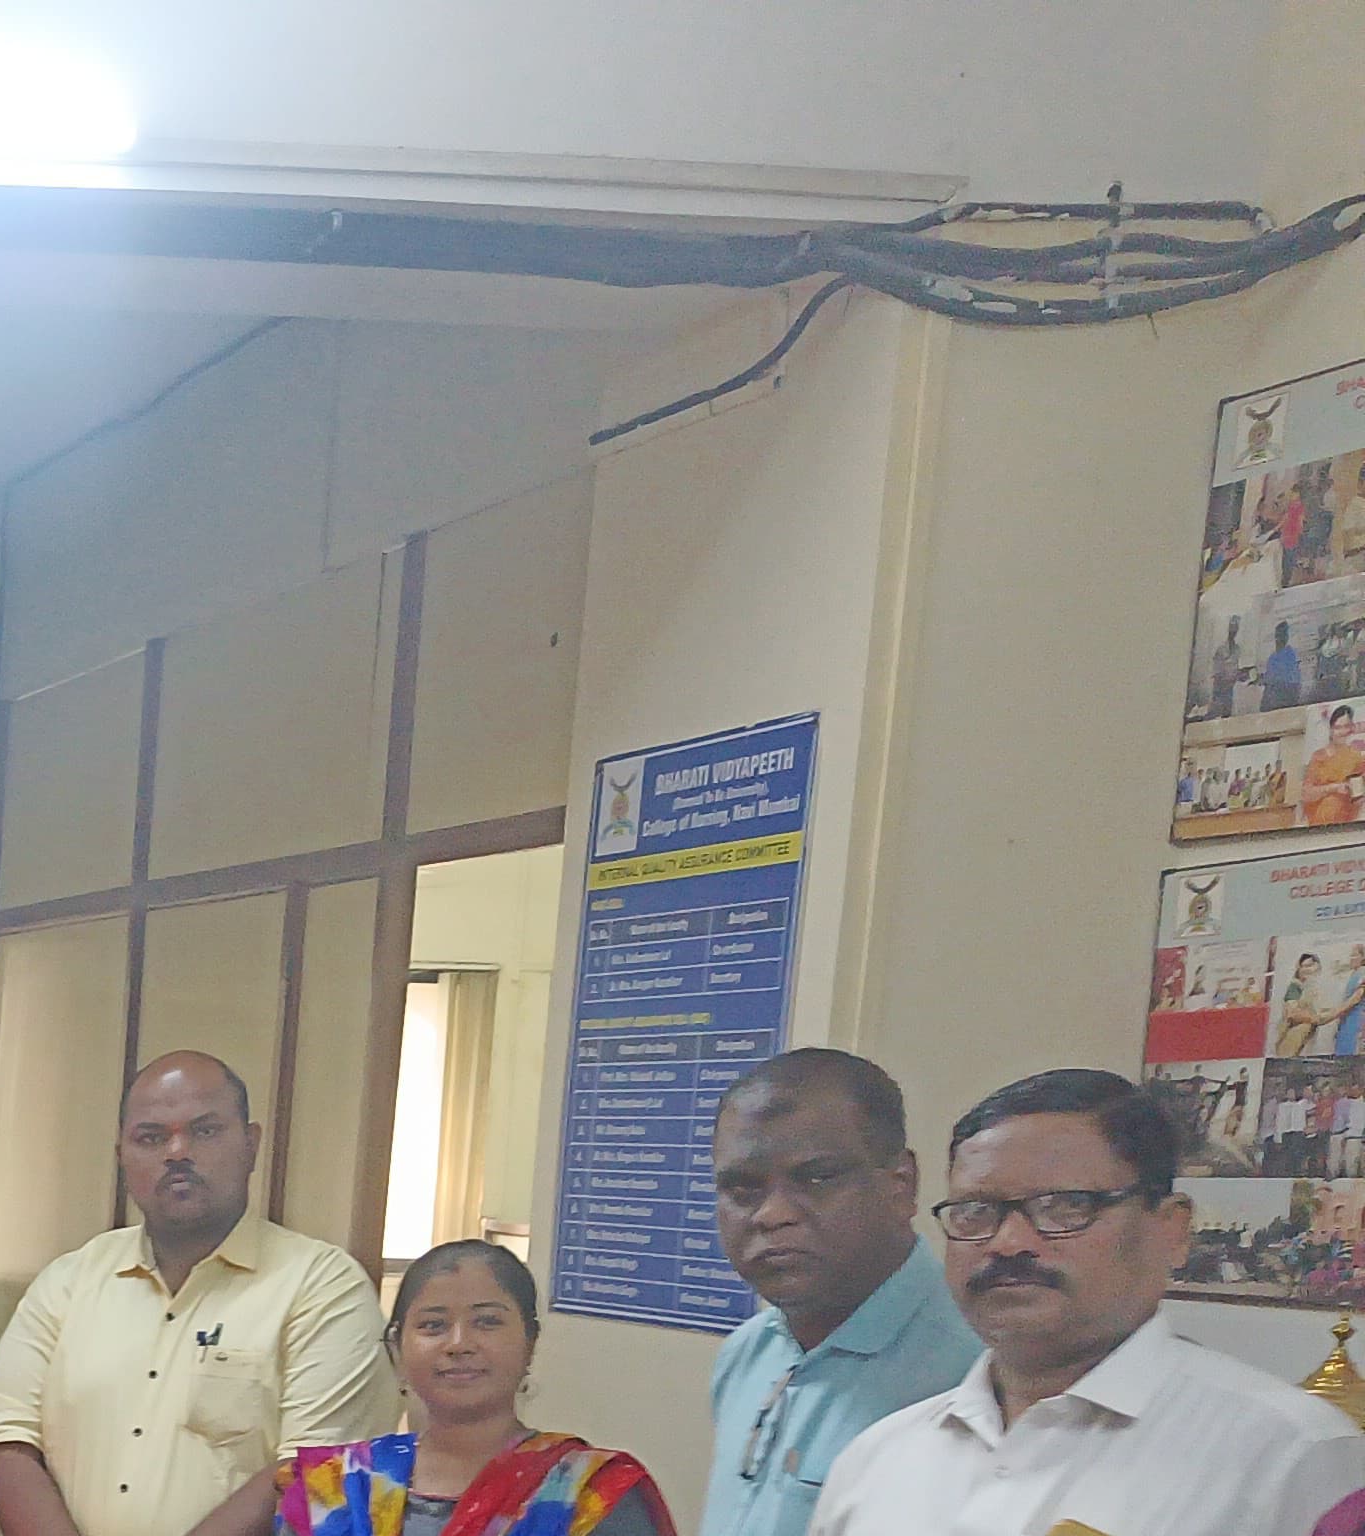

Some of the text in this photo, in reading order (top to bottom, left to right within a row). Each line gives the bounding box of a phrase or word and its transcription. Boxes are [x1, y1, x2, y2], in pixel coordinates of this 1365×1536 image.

[654, 747, 795, 795] BHARATI VIDYAPEETH
[1290, 879, 1354, 899] COLLEGE
